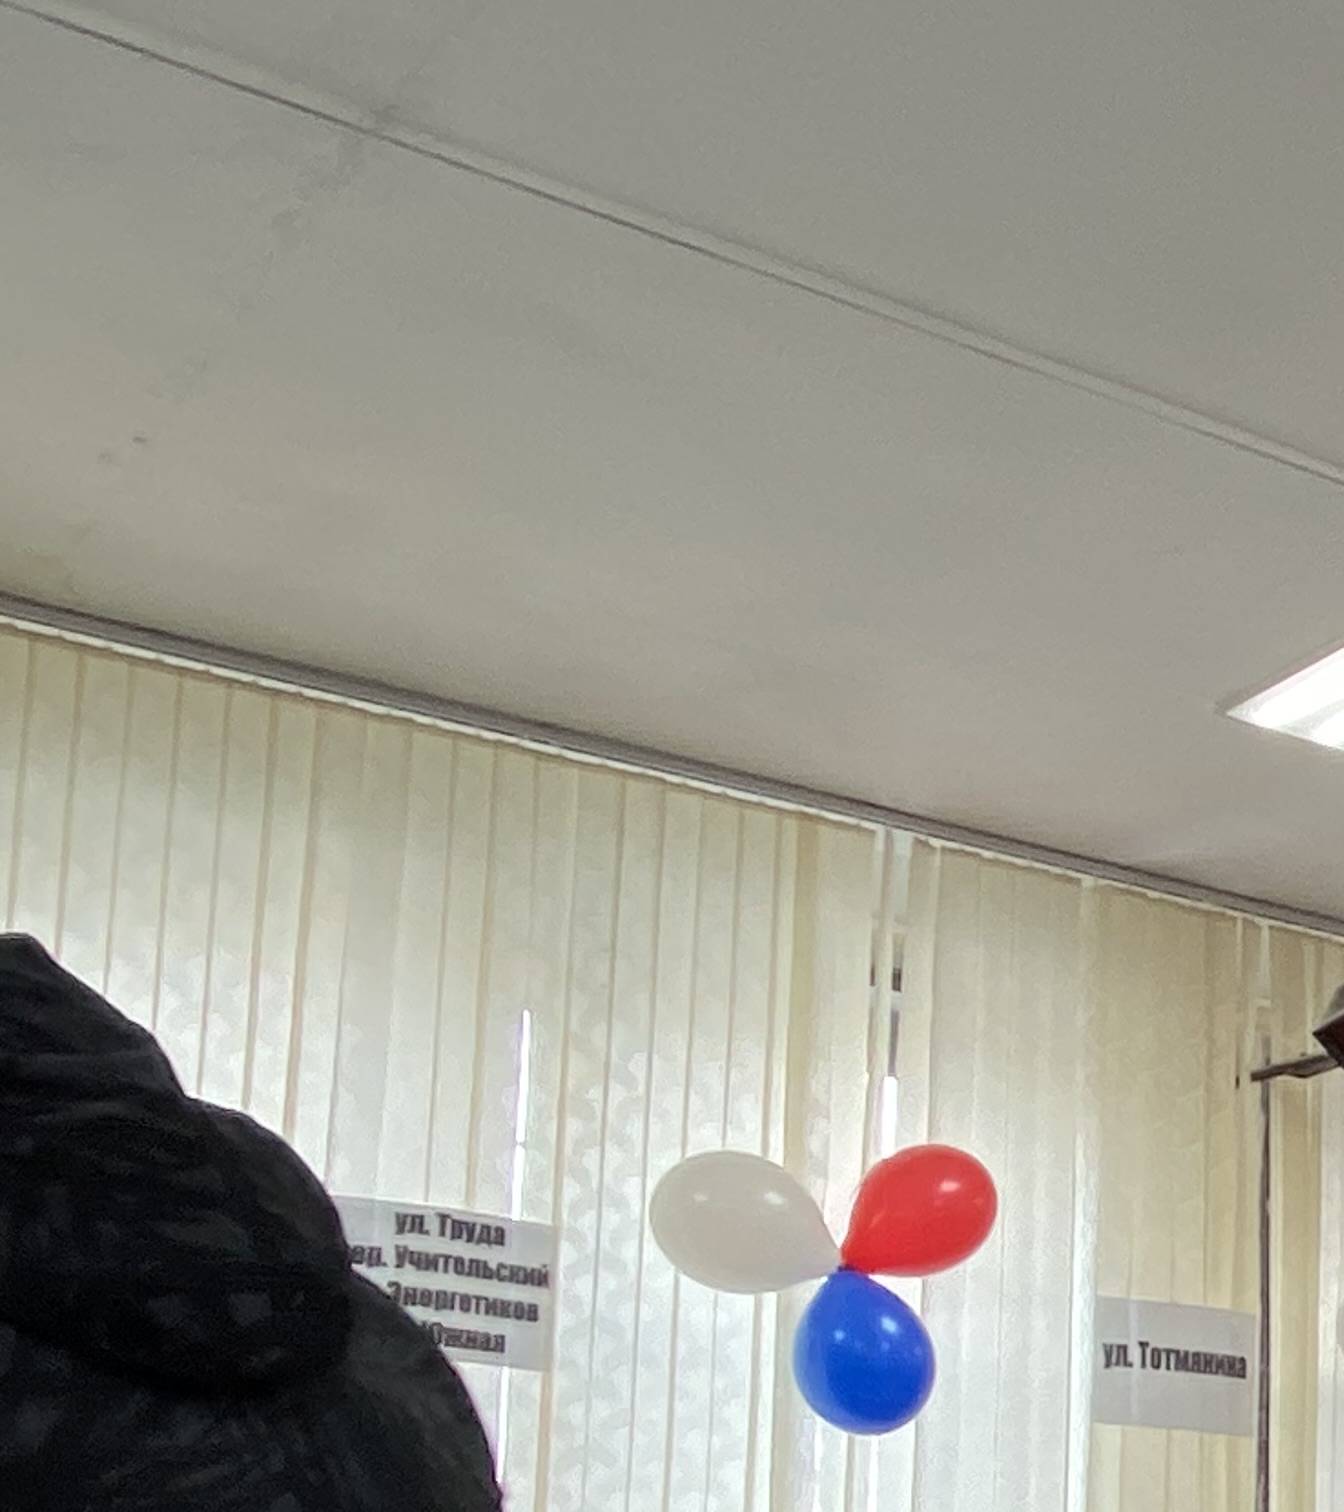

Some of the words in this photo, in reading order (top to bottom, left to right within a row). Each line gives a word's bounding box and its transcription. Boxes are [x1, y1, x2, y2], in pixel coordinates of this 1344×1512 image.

[395, 1212, 430, 1235] ул.
[437, 1212, 505, 1246] Труда
[395, 1245, 550, 1287] Учительский
[1103, 1343, 1133, 1368] ул.
